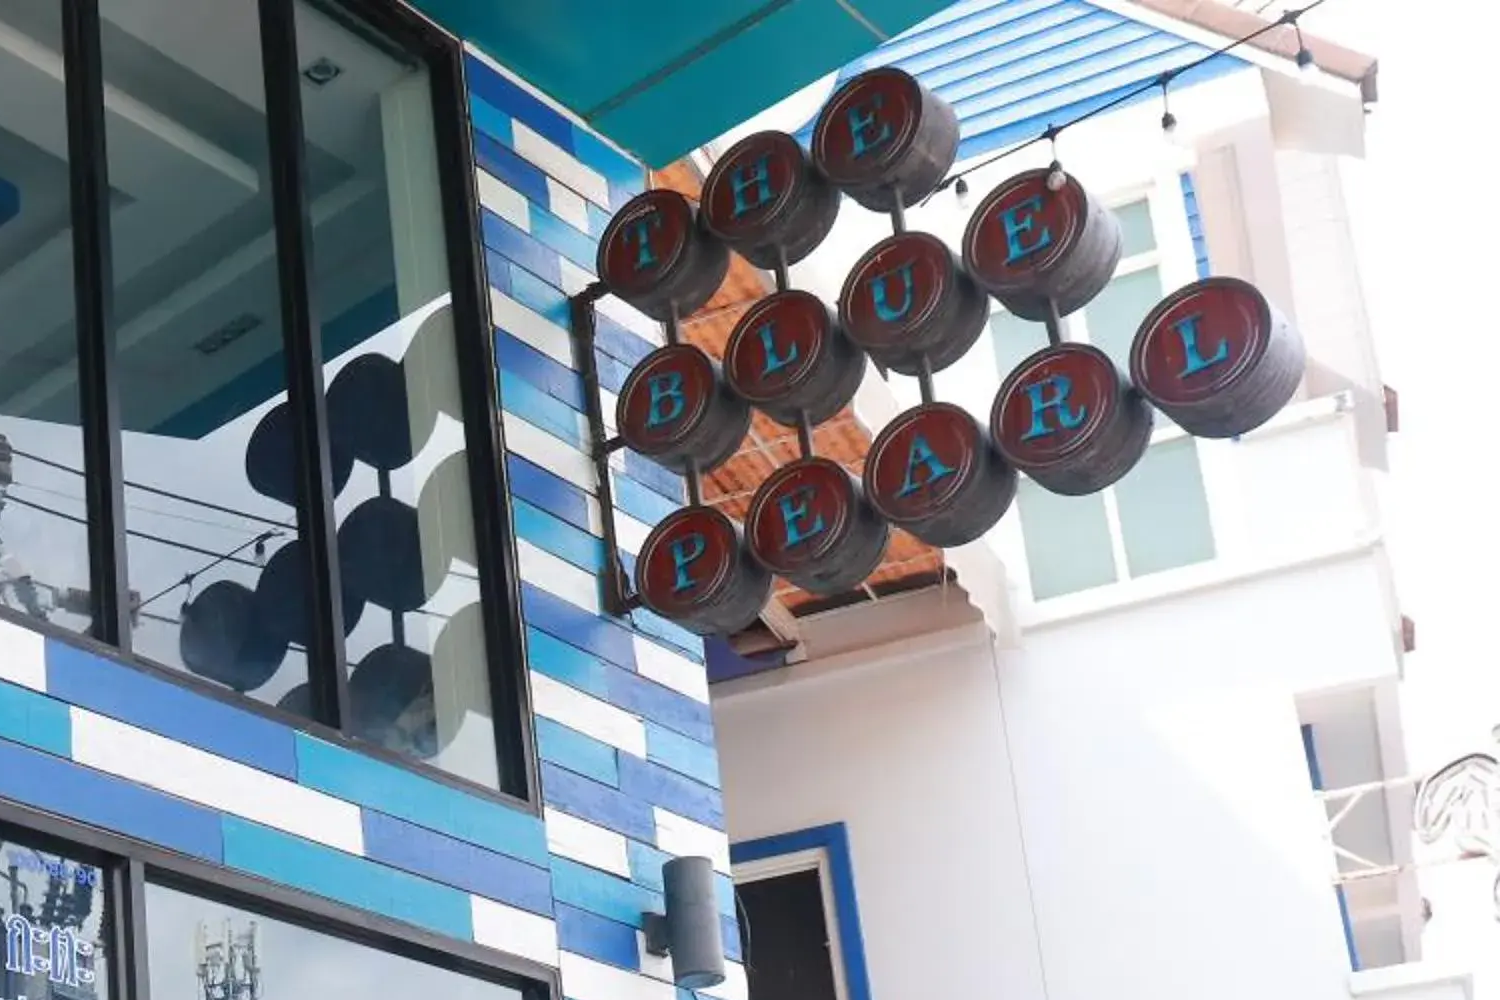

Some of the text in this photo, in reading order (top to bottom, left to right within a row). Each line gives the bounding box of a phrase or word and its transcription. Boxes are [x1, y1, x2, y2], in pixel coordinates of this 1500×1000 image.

[623, 94, 898, 270] THE
[646, 194, 1054, 429] BLUE
[669, 308, 1231, 593] PEARL
